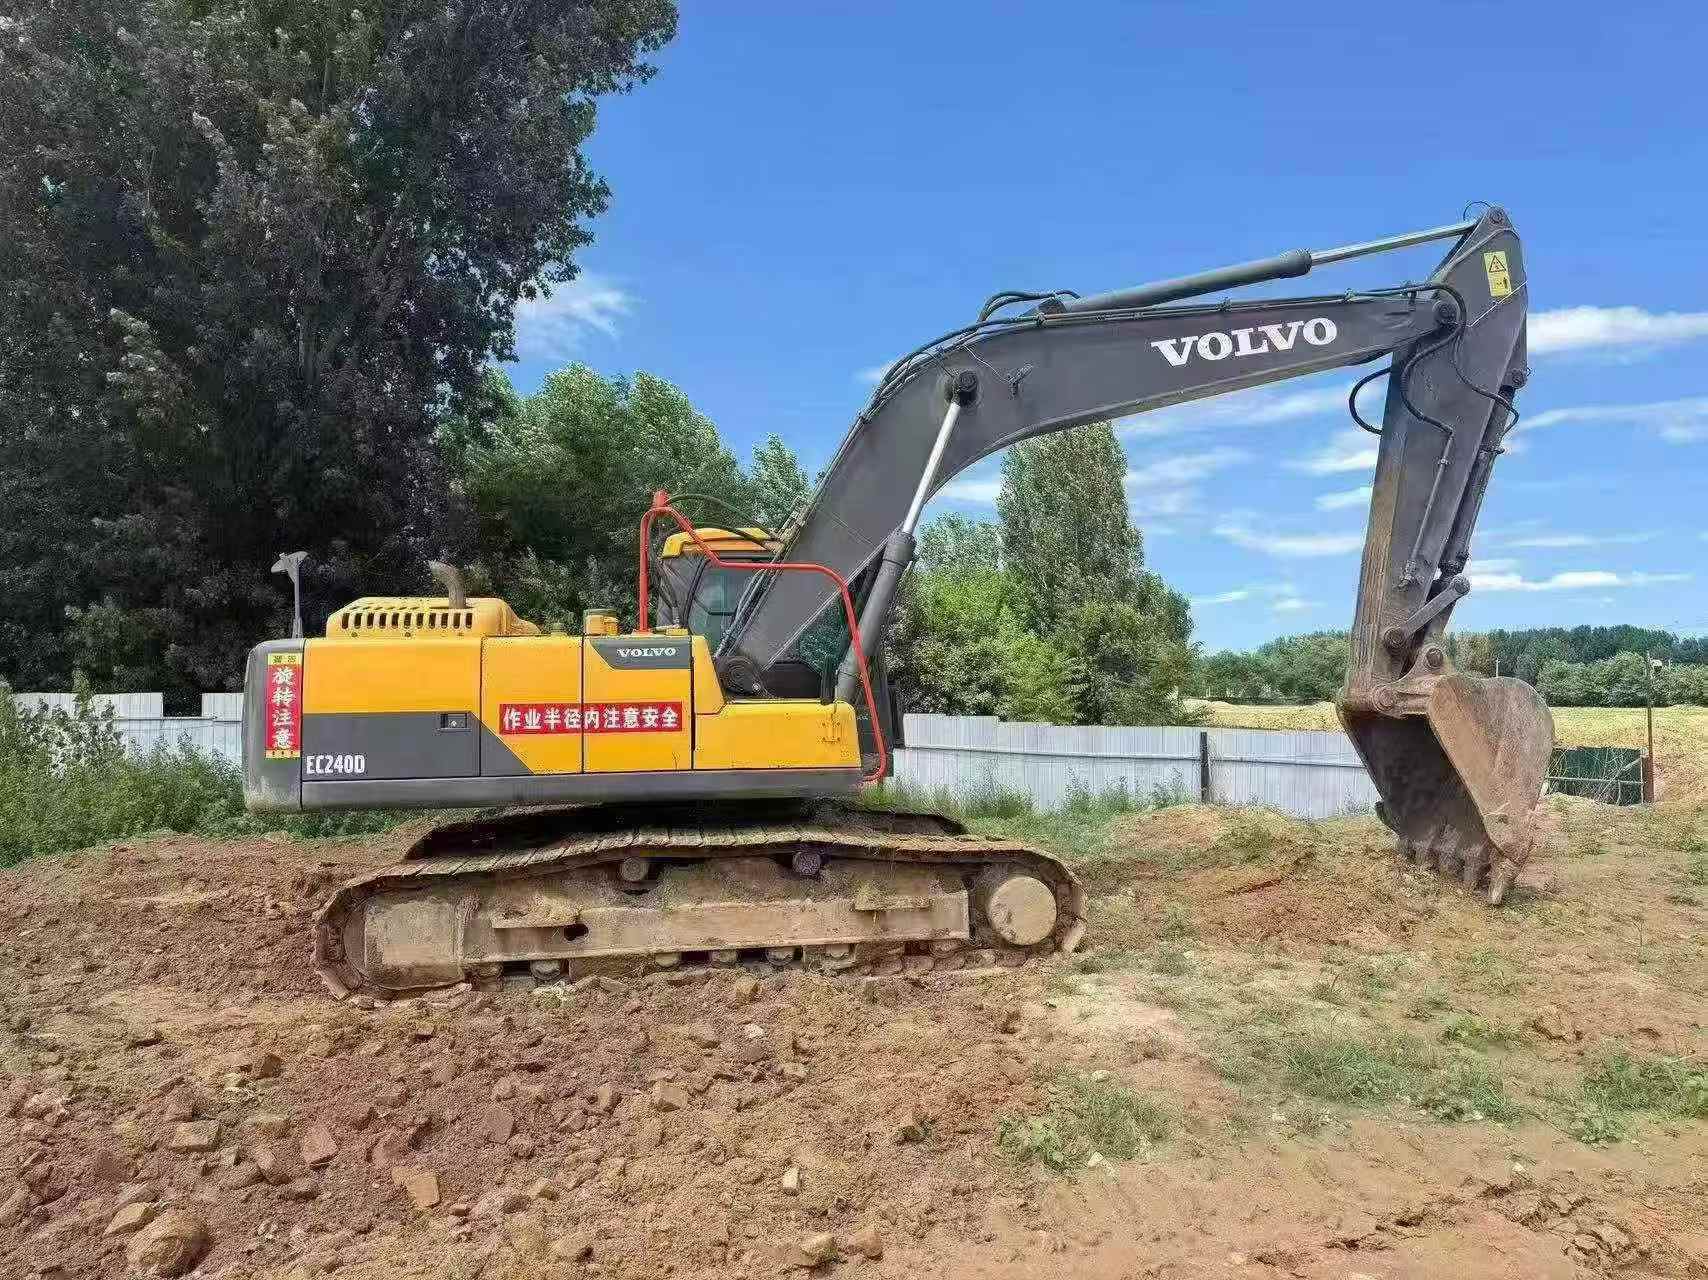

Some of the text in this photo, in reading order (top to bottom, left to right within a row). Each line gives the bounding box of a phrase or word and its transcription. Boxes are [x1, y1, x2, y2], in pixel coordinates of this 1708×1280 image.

[1152, 317, 1338, 366] VOLVO
[617, 647, 676, 657] VOLVO
[272, 666, 295, 749] 旋转注意
[503, 706, 678, 730] 作业半径内注意安全
[306, 754, 366, 774] EC240D
